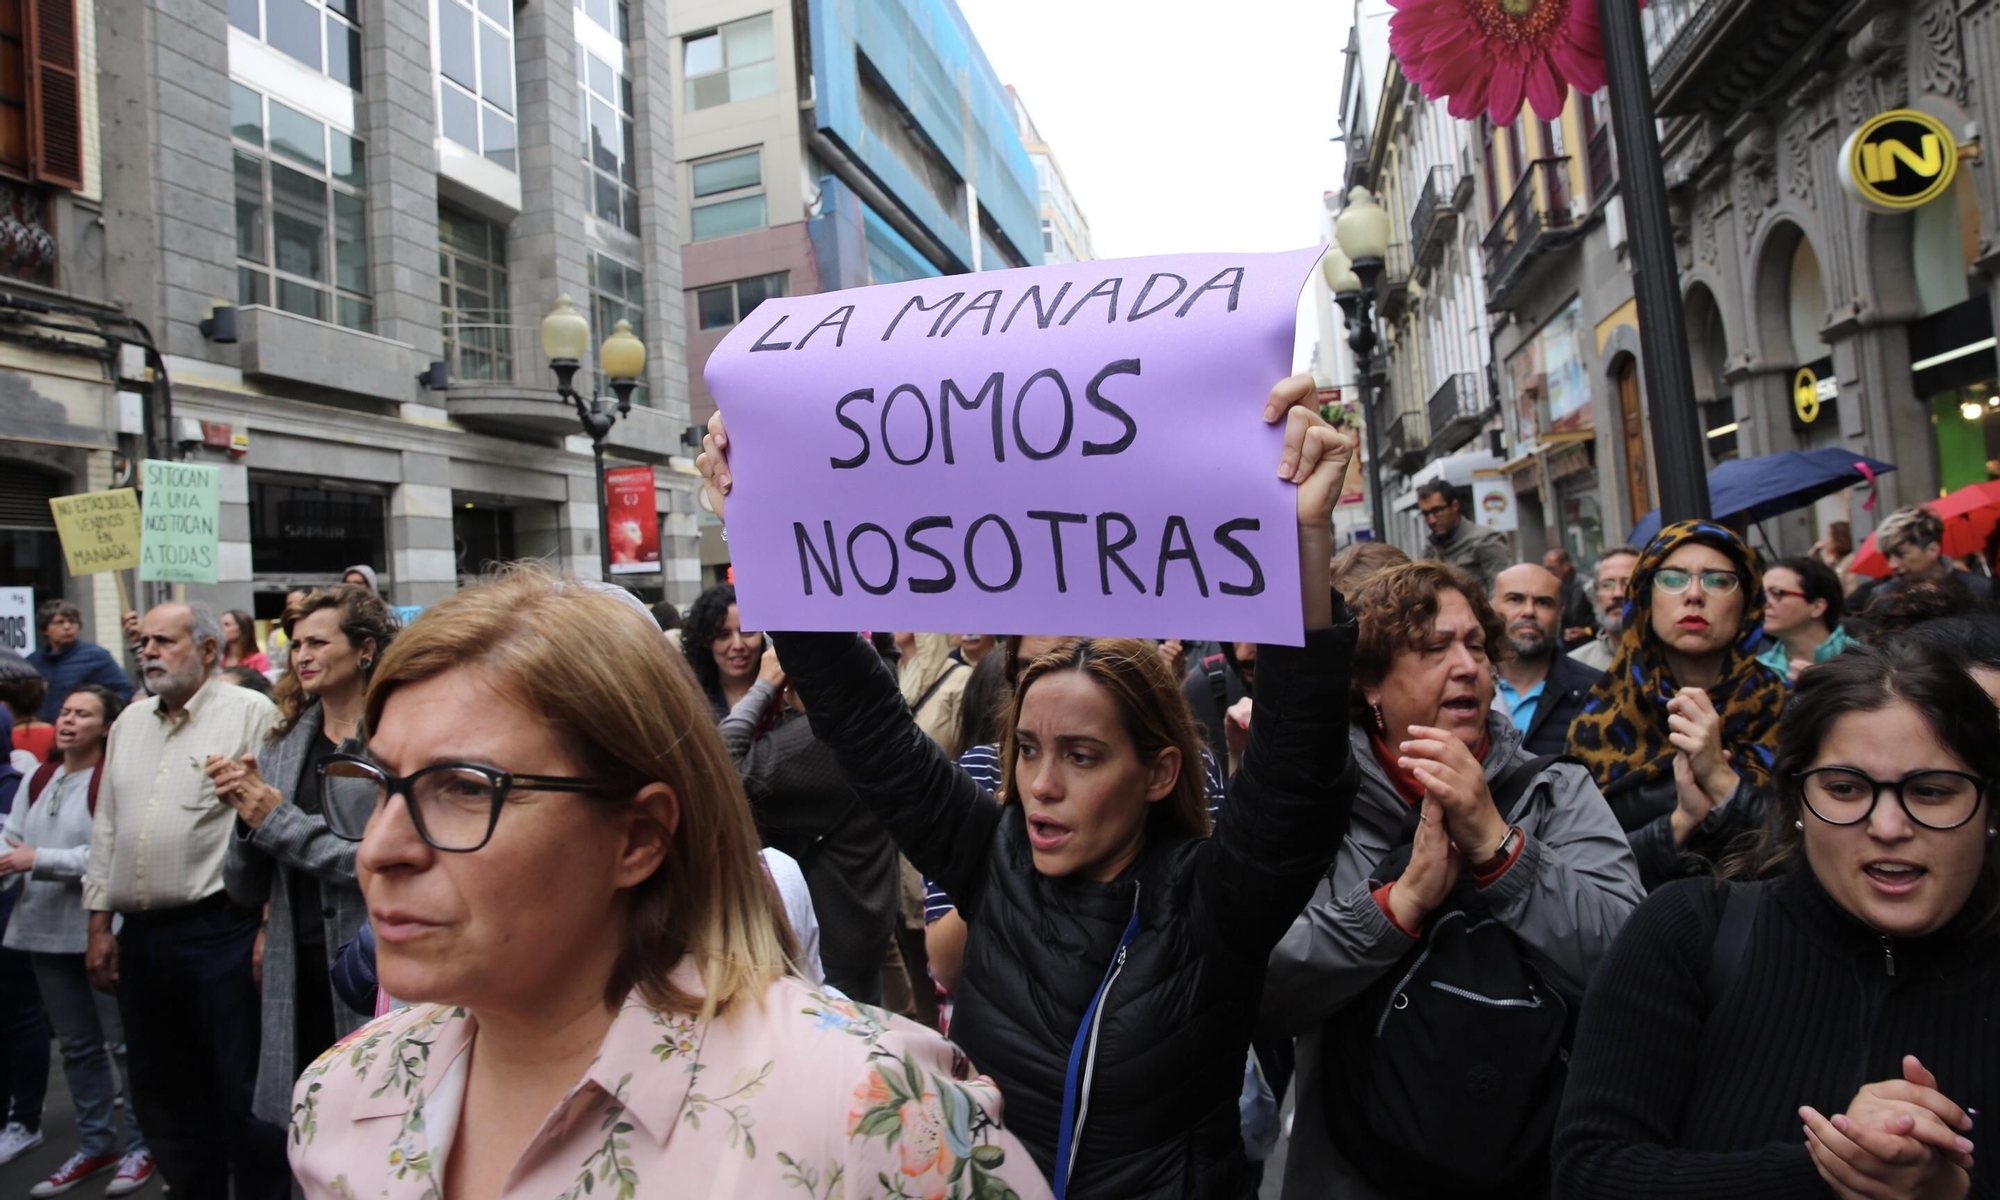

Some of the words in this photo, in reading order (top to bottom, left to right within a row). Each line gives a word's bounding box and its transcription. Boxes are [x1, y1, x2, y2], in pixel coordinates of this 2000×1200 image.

[1863, 133, 1942, 183] IN
[749, 305, 855, 353] LA
[881, 266, 1245, 342] MANADA
[829, 358, 1141, 470] SOMOS
[148, 465, 163, 486] SI
[164, 467, 209, 488] TOCAN
[150, 491, 160, 508] A
[168, 492, 201, 510] UNA
[145, 514, 167, 532] NOS
[169, 515, 213, 535] TOCAN
[143, 545, 155, 564] A
[158, 545, 212, 568] TODAS
[792, 510, 1266, 599] NOSOTRAS
